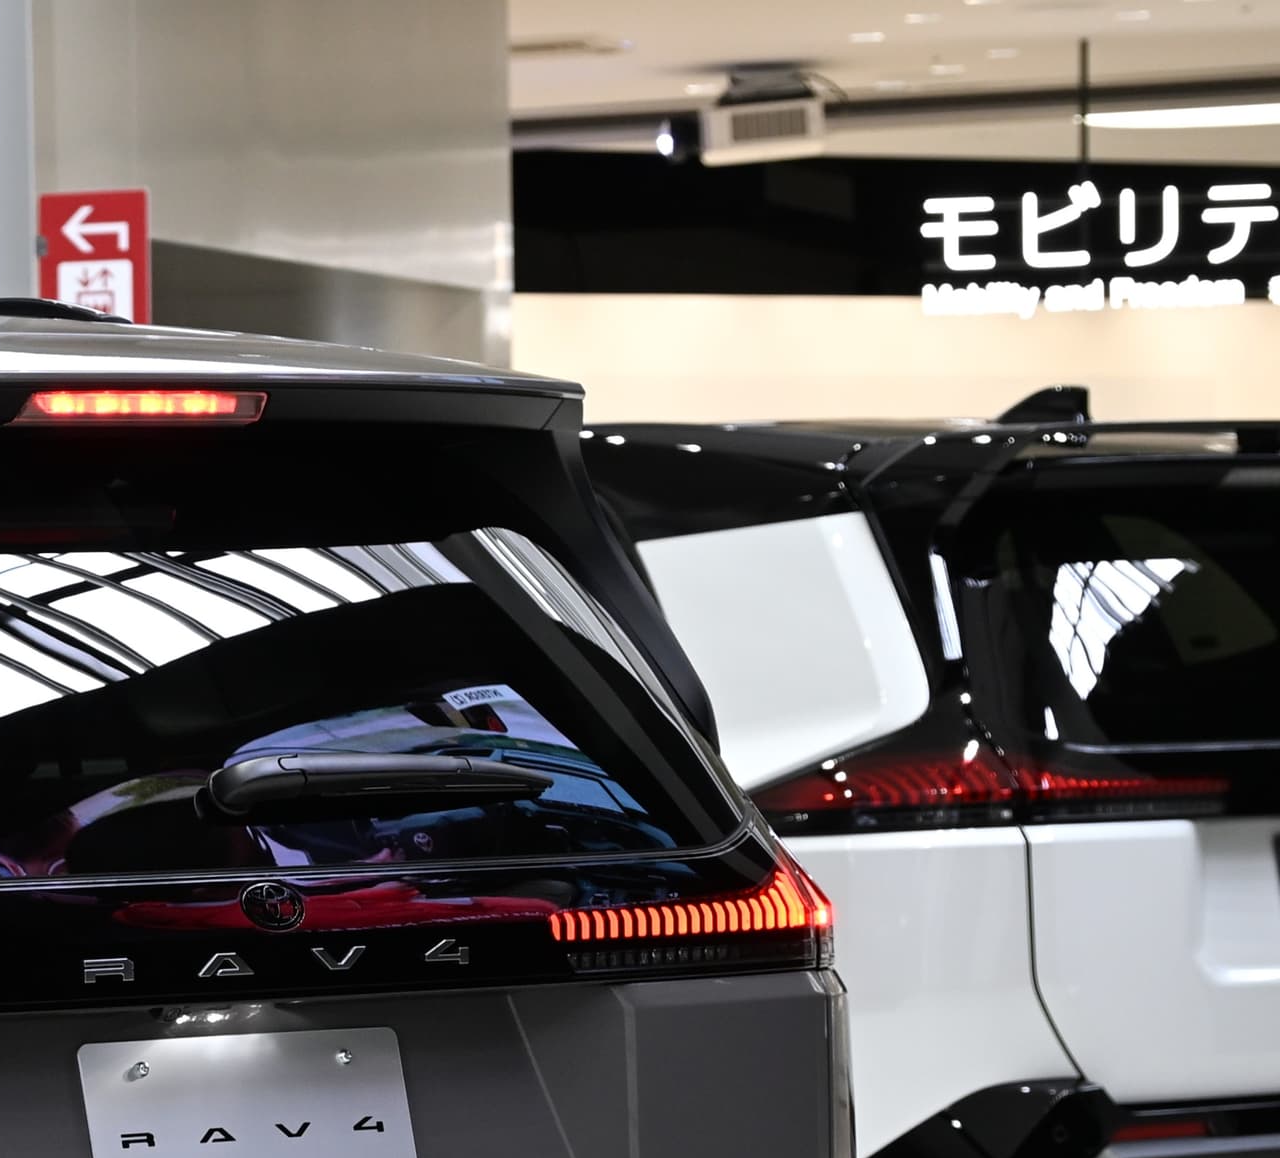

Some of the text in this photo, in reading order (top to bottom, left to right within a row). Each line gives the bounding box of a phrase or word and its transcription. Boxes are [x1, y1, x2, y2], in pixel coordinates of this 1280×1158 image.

[920, 180, 1278, 271] モビリテ
[83, 938, 470, 984] RAV4
[120, 1115, 385, 1149] RAV4
